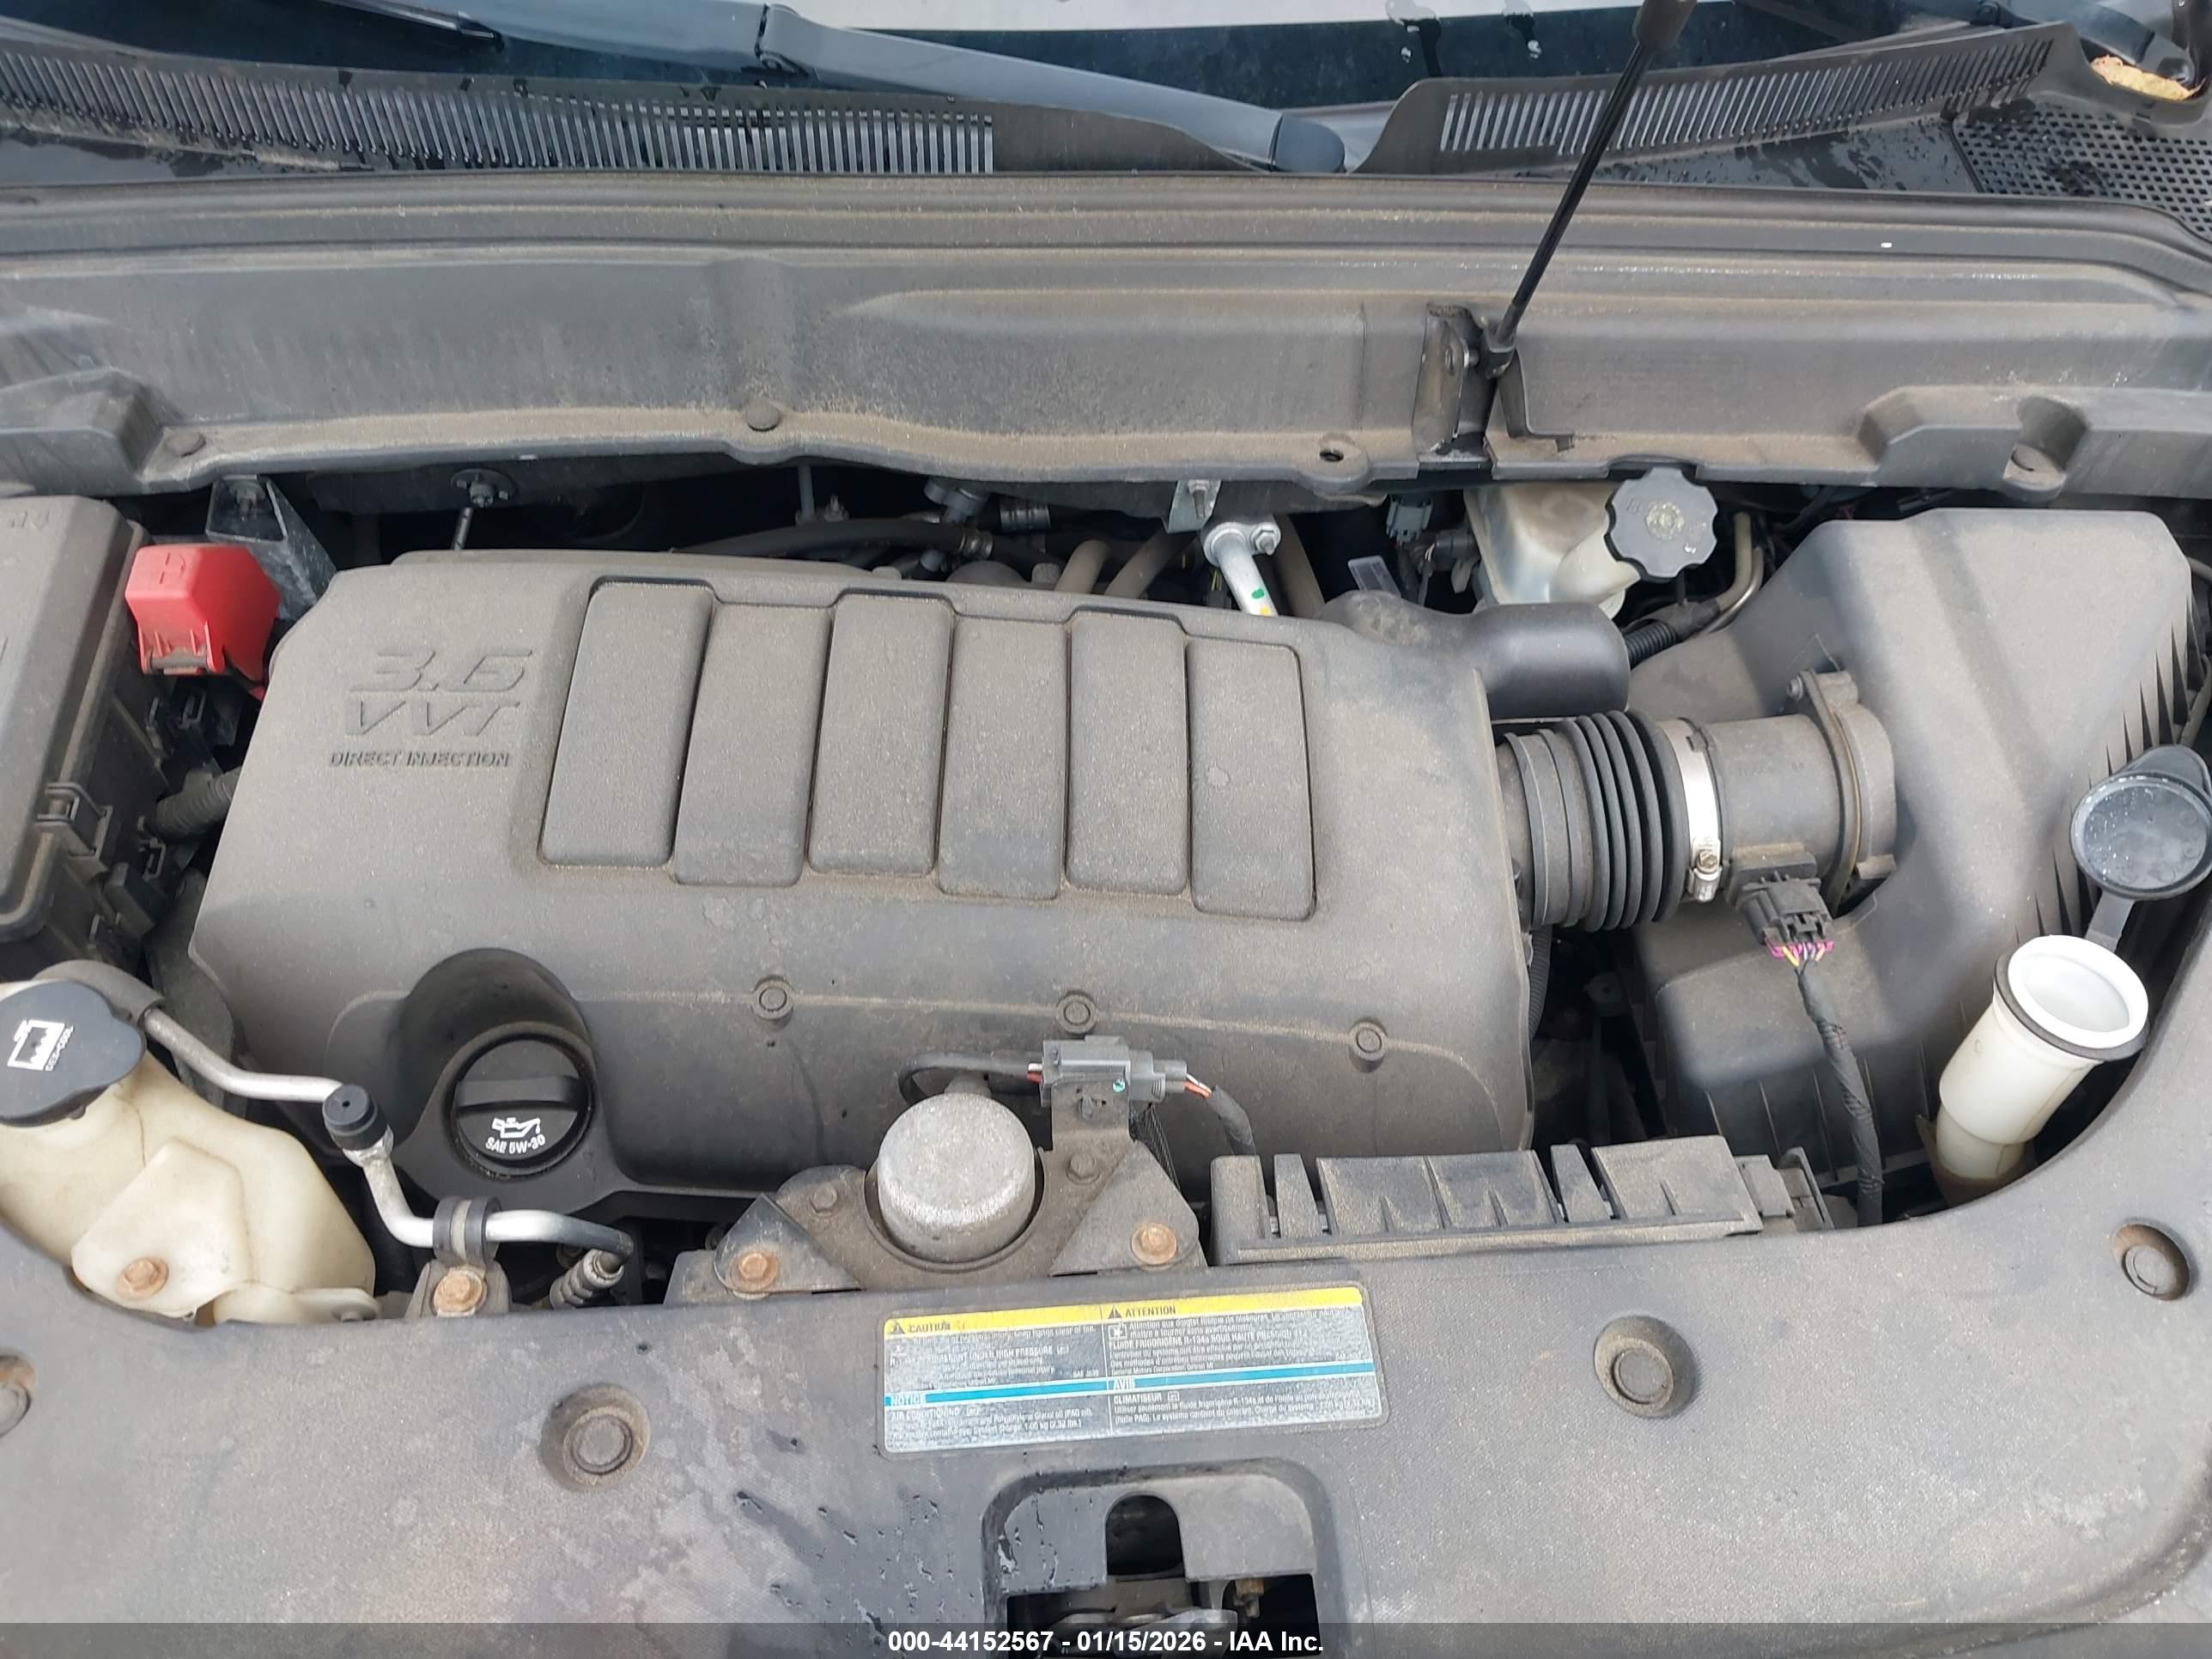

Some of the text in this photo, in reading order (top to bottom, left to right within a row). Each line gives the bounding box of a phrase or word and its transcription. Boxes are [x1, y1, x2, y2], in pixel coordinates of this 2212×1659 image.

[349, 650, 533, 693] 3.6
[344, 700, 521, 736] VVT
[331, 751, 510, 768] DIRECT INJECTION
[485, 1133, 545, 1154] SAE 5W-30
[1126, 1305, 1176, 1317] ATTENTION
[1114, 1392, 1163, 1405] CLIMATISEUR
